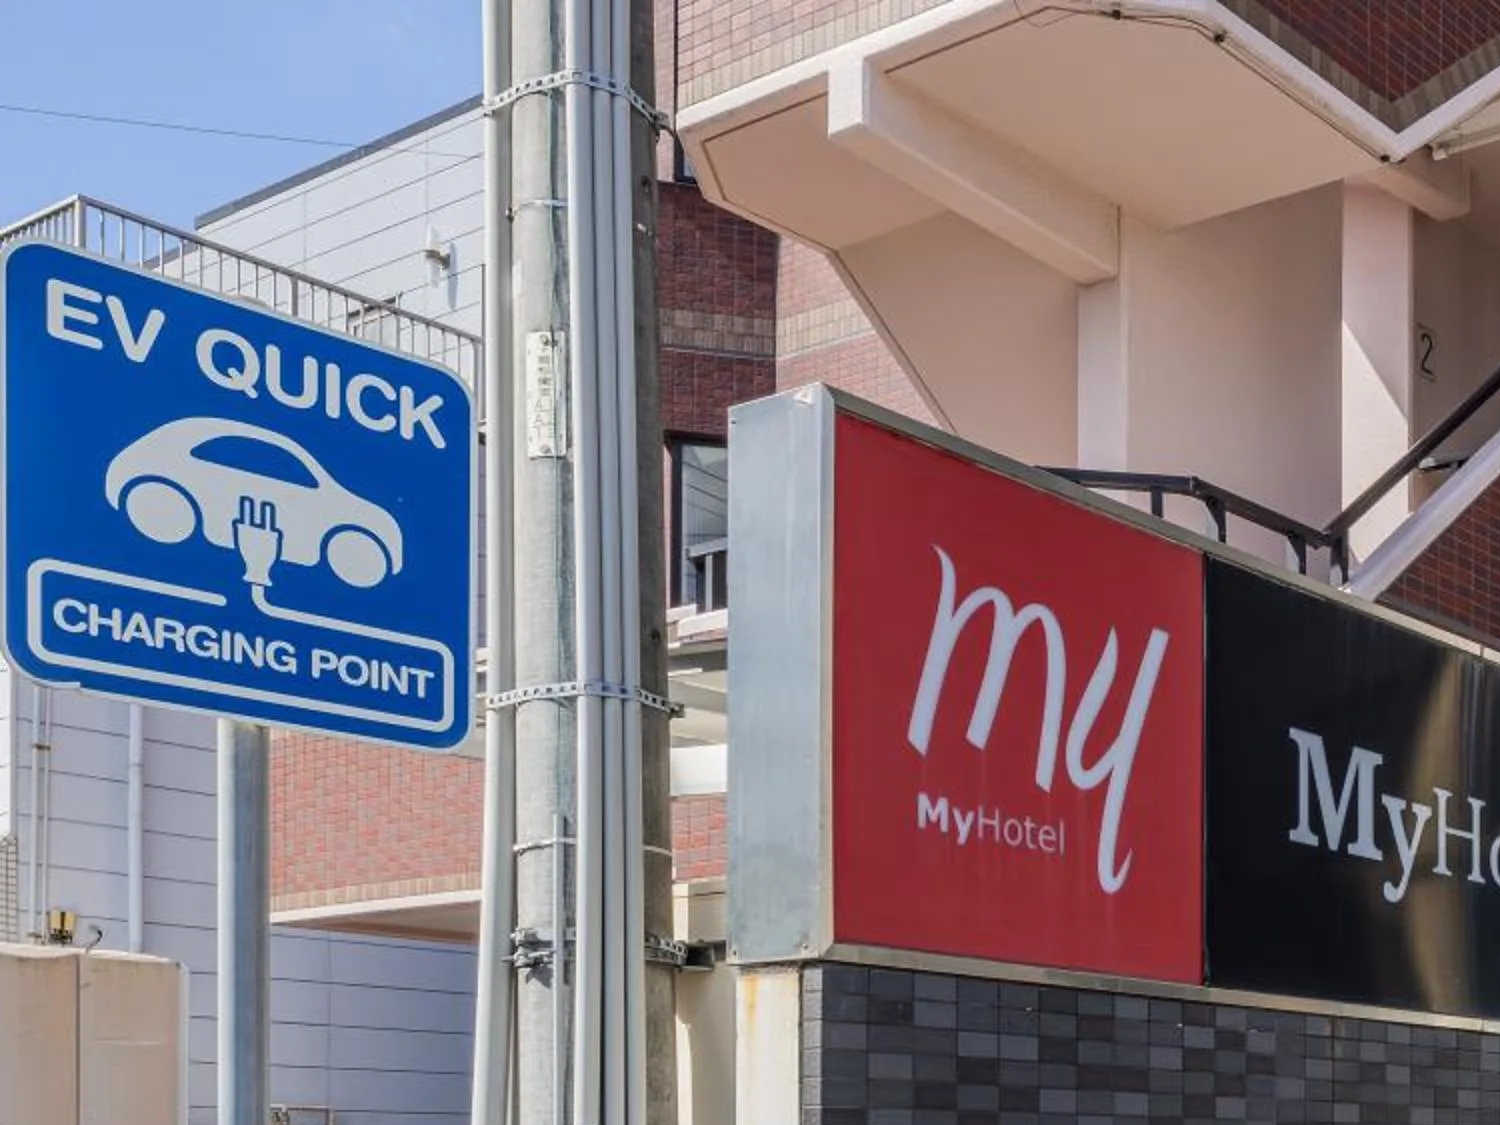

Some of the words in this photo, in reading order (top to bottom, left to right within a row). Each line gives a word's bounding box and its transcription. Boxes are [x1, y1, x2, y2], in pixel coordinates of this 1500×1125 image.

[46, 278, 165, 363] EV
[196, 328, 446, 449] QUICK
[53, 598, 297, 675] CHARGING
[311, 647, 435, 699] POINT
[917, 793, 1065, 855] MyHotel
